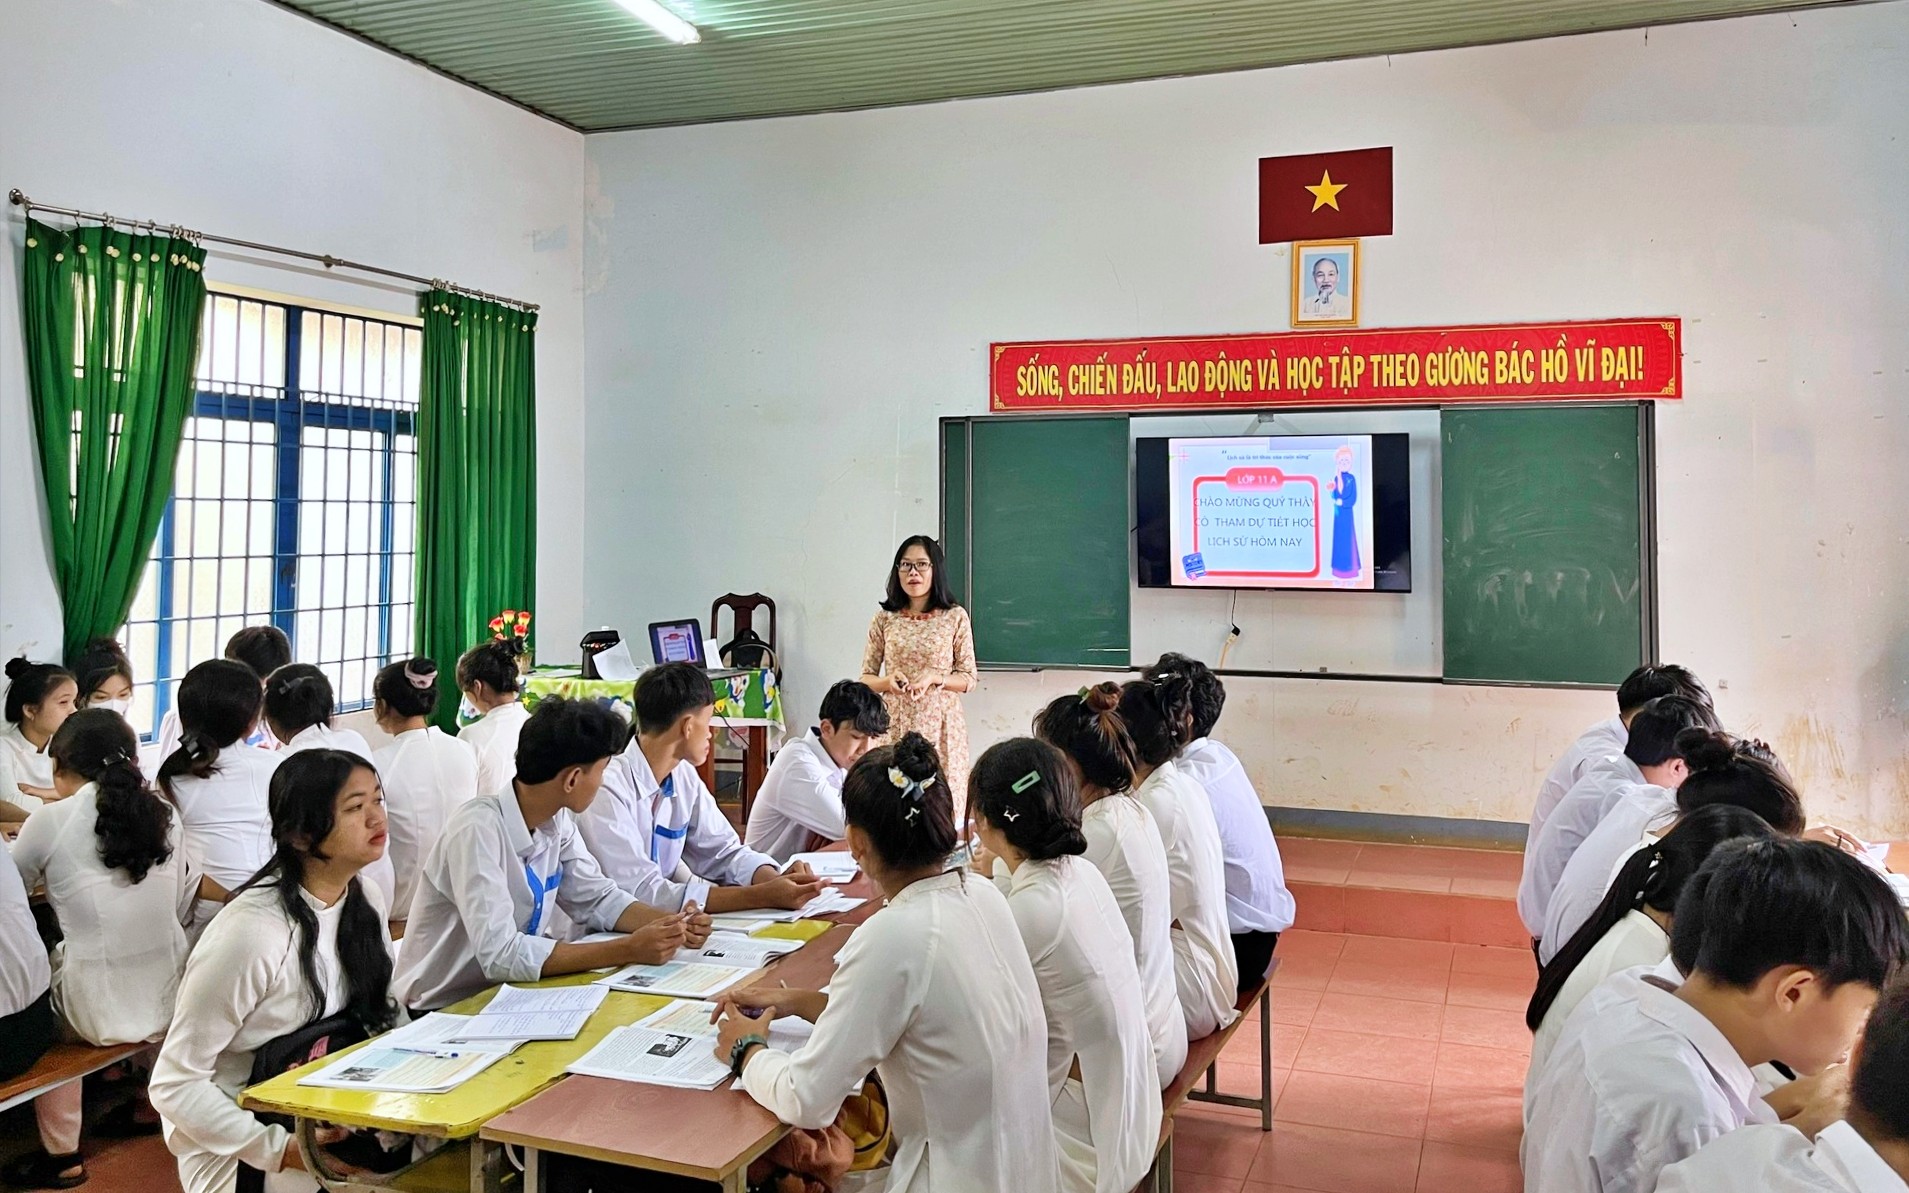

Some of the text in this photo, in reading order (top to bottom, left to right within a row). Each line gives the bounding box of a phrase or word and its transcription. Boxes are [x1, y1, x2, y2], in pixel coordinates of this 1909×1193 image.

[1016, 333, 1644, 402] SỐNG, CHIẾN ĐẤU, LAO ĐỘNG VÀ HỌC TẬP THEO GƯƠNG BÁC HỒ VĨ ĐẠI!
[1237, 473, 1278, 485] LỚP 11 A
[1193, 496, 1223, 507] CHÀO
[1263, 496, 1286, 508] QUÝ
[1215, 517, 1246, 527] THAM
[1248, 517, 1266, 528] DỰ
[1292, 517, 1318, 528] HỌC
[1280, 537, 1303, 547] NAY
